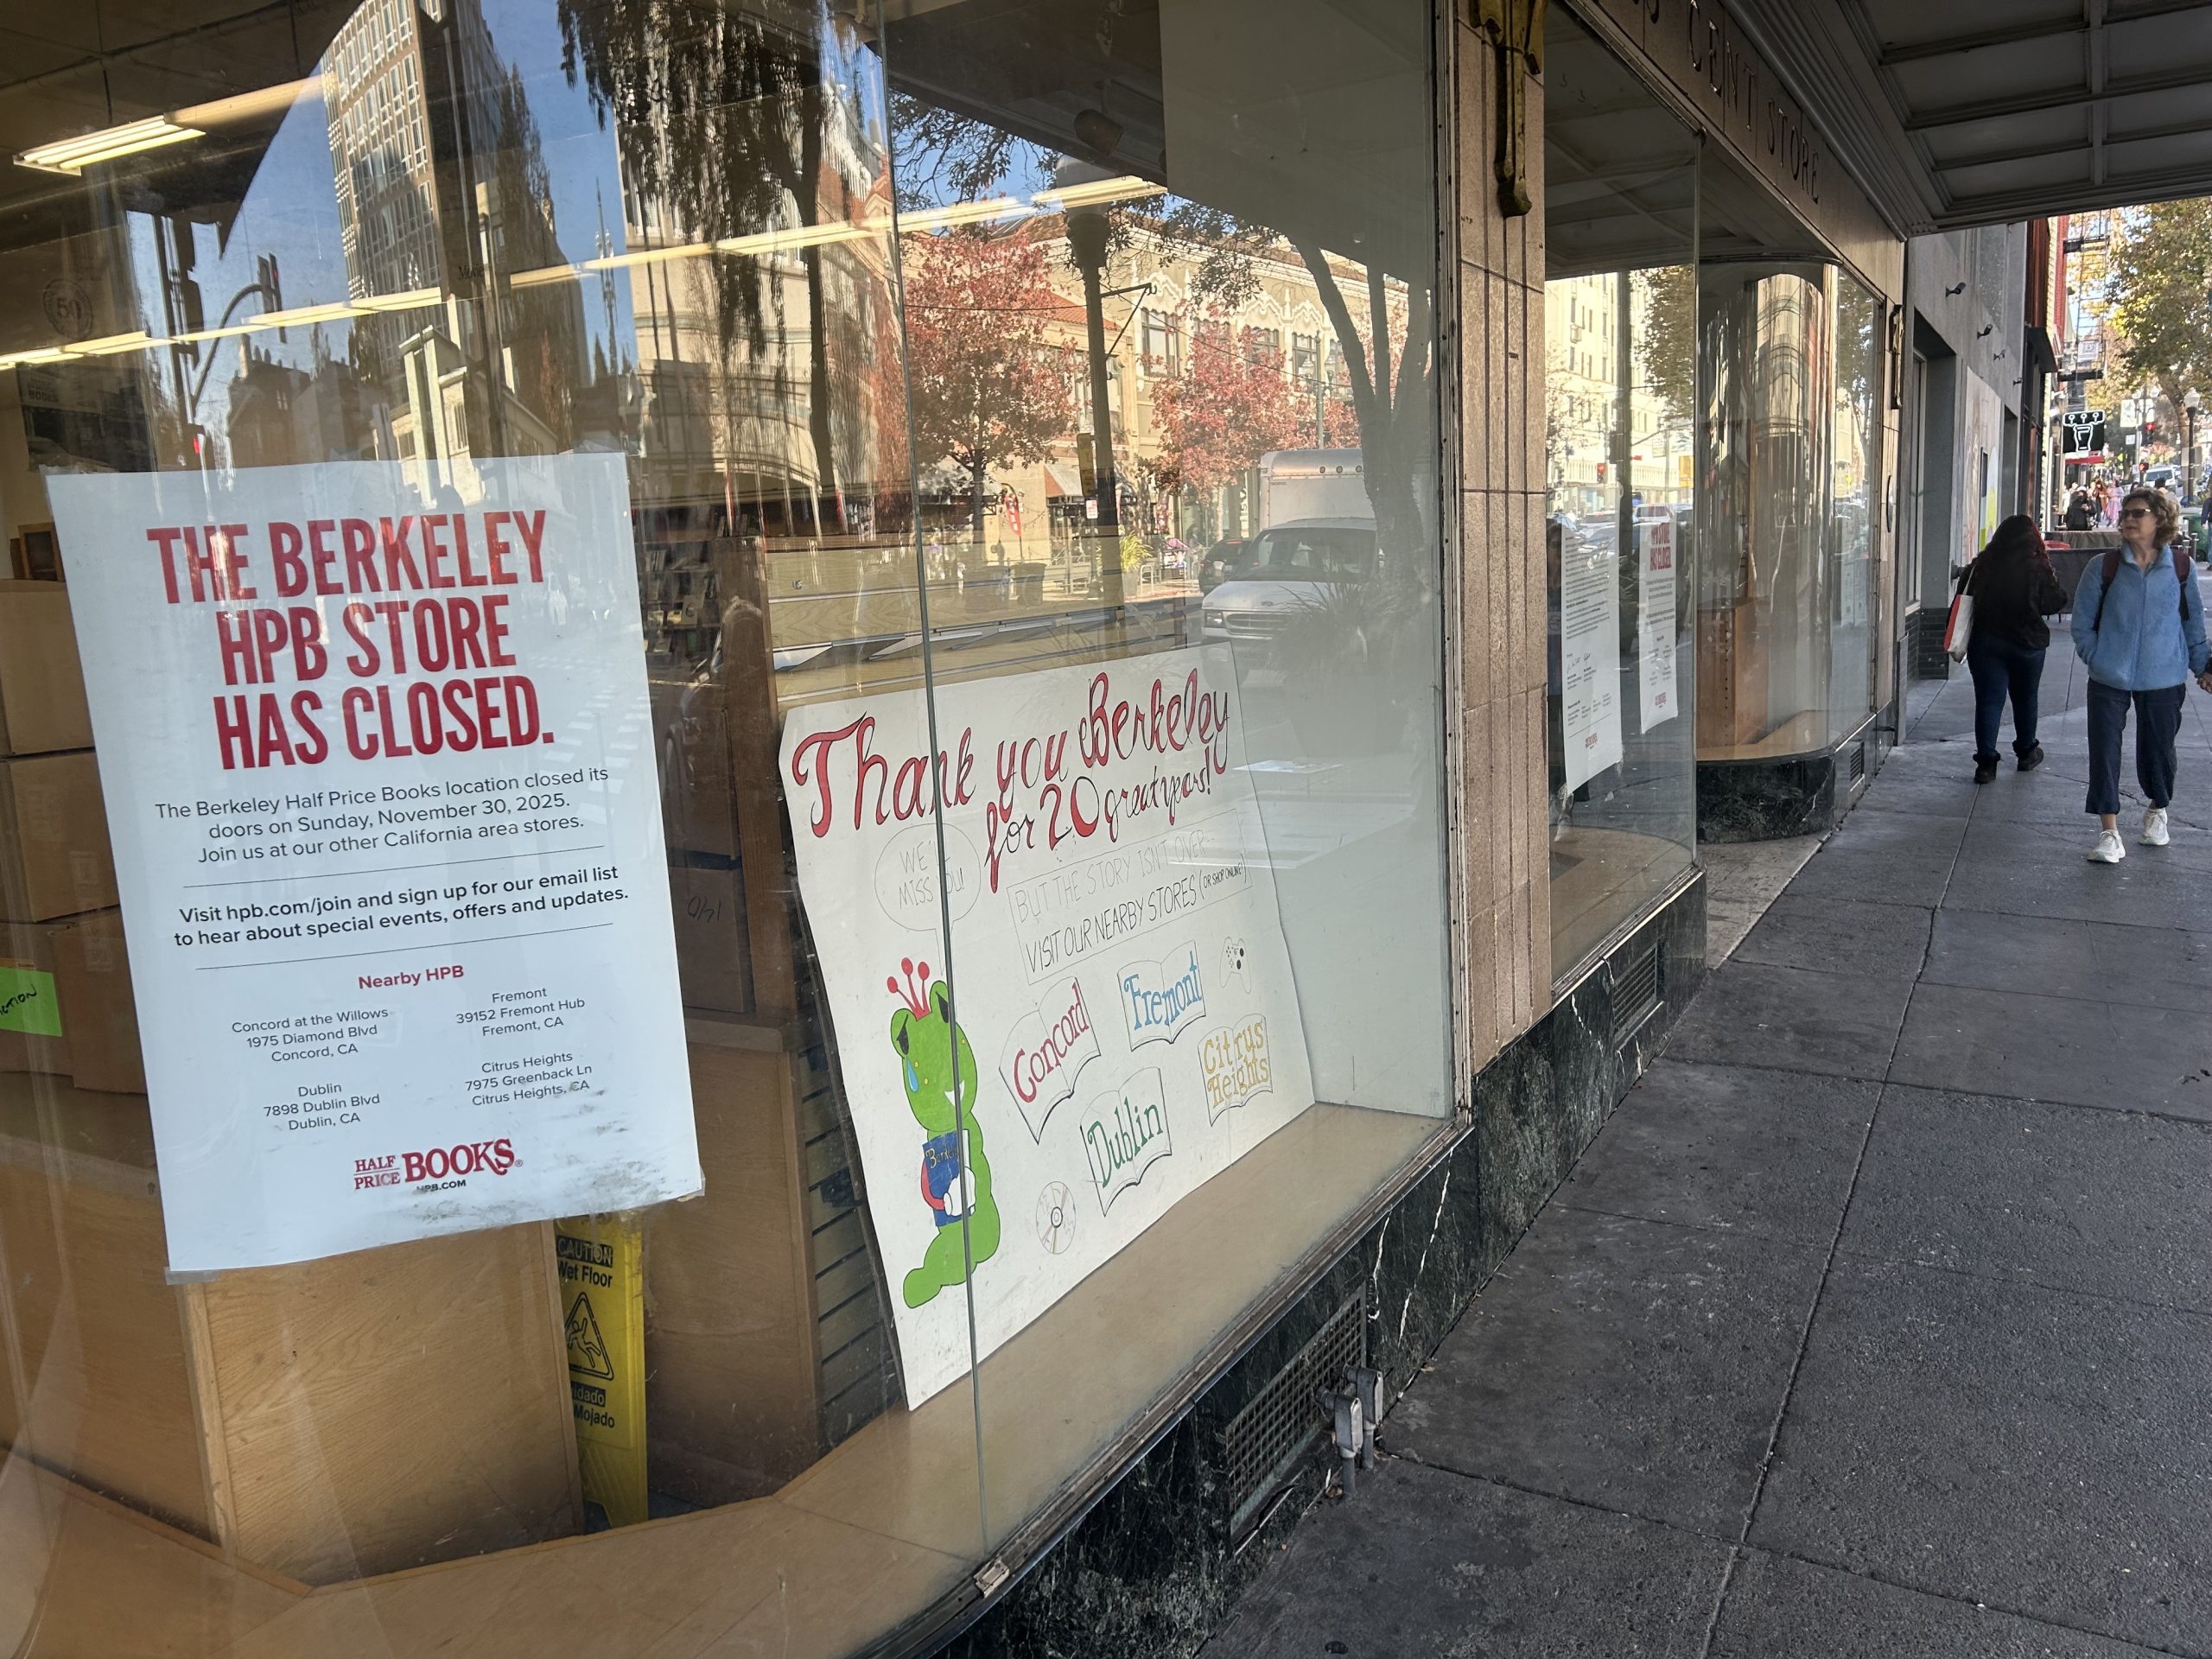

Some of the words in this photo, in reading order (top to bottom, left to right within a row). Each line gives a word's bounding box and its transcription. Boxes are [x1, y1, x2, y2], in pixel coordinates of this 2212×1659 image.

[1768, 97, 1819, 205] STORE
[147, 524, 257, 603] THE
[269, 510, 546, 598] BERKELEY
[217, 607, 327, 684] HPB
[343, 594, 515, 677] STORE
[214, 690, 327, 770] HAS
[343, 676, 554, 760] CLOSED.
[791, 710, 976, 838] Thank
[997, 729, 1069, 823] you
[1077, 668, 1230, 775] Berkeley
[155, 804, 191, 818] The
[196, 798, 280, 816] Berkeley
[286, 792, 323, 809] Half
[329, 791, 376, 806] Price
[382, 784, 441, 801] Books
[446, 778, 518, 795] location
[524, 769, 583, 787] closed
[589, 768, 608, 781] its
[209, 823, 263, 838] doors
[269, 822, 292, 834] on
[298, 814, 372, 831] Sunday,
[378, 804, 477, 824] November
[482, 799, 511, 814] 30,
[516, 793, 569, 810] 2025.
[198, 847, 237, 862] Join
[243, 848, 264, 859] us
[270, 843, 288, 857] at
[293, 842, 324, 855] our
[329, 836, 378, 852] other
[385, 826, 473, 846] California
[479, 823, 518, 837] area
[524, 817, 583, 832] stores.
[984, 801, 1035, 893] for
[1039, 776, 1100, 851] 20
[179, 906, 222, 922] Visit
[226, 896, 352, 922] hpb.com/join
[358, 891, 392, 908] and
[398, 888, 437, 906] sign
[443, 887, 467, 901] up
[472, 881, 498, 895] for
[503, 879, 533, 892] our
[539, 869, 588, 887] email
[593, 867, 618, 881] list
[899, 876, 933, 909] MISS
[1014, 881, 1049, 923] BUT
[1052, 870, 1081, 906] THE
[1087, 852, 1130, 894] STORY
[1137, 839, 1168, 877] ISN'T
[175, 933, 193, 946] to
[198, 931, 240, 944] hear
[246, 924, 302, 941] about
[307, 915, 373, 938] special
[379, 910, 448, 928] events,
[453, 904, 506, 919] offers
[512, 896, 545, 912] and
[551, 889, 628, 910] updates.
[1026, 930, 1061, 973] VISIT
[1064, 919, 1091, 956] OUR
[1095, 896, 1143, 941] NEARBY
[1147, 874, 1197, 921] STORES
[359, 972, 421, 988] Nearby
[426, 965, 464, 981] HPB
[493, 988, 547, 1003] Fremont
[1123, 950, 1203, 1031] Fremont
[232, 1018, 289, 1033] Concord
[295, 1017, 308, 1027] at
[310, 1015, 332, 1025] the
[337, 1009, 388, 1022] Willows
[456, 1009, 496, 1023] 39152
[500, 1002, 555, 1018] Fremont
[558, 998, 585, 1009] Hub
[482, 1021, 540, 1036] Fremont,
[544, 1017, 563, 1027] CA
[246, 1035, 278, 1047] 1975
[283, 1028, 344, 1044] Diamond
[348, 1025, 377, 1037] Blvd
[271, 1046, 334, 1061] Concord,
[338, 1044, 358, 1054] CA
[1014, 982, 1090, 1103] Concord
[1203, 1020, 1265, 1075] Citrus
[465, 1077, 498, 1091] 7975
[503, 1067, 573, 1085] Greenback
[577, 1065, 592, 1075] Ln
[482, 1061, 519, 1072] Citrus
[524, 1053, 573, 1067] Heights
[1207, 1057, 1269, 1109] Heights
[264, 1103, 299, 1116] 7898
[303, 1099, 346, 1112] Dublin
[351, 1094, 379, 1106] Blvd
[298, 1084, 341, 1096] Dublin
[473, 1094, 510, 1105] Citrus
[569, 1080, 589, 1091] CA
[289, 1116, 335, 1130] Dublin,
[340, 1113, 360, 1123] CA
[1087, 1096, 1164, 1189] Dublin
[354, 1154, 396, 1173] HALF
[402, 1138, 515, 1183] BOOKS
[354, 1172, 400, 1190] PRICE
[557, 1237, 613, 1265] CAUTION
[557, 1260, 578, 1281] Wet
[582, 1264, 613, 1287] Floor
[574, 1404, 615, 1428] Mojado
